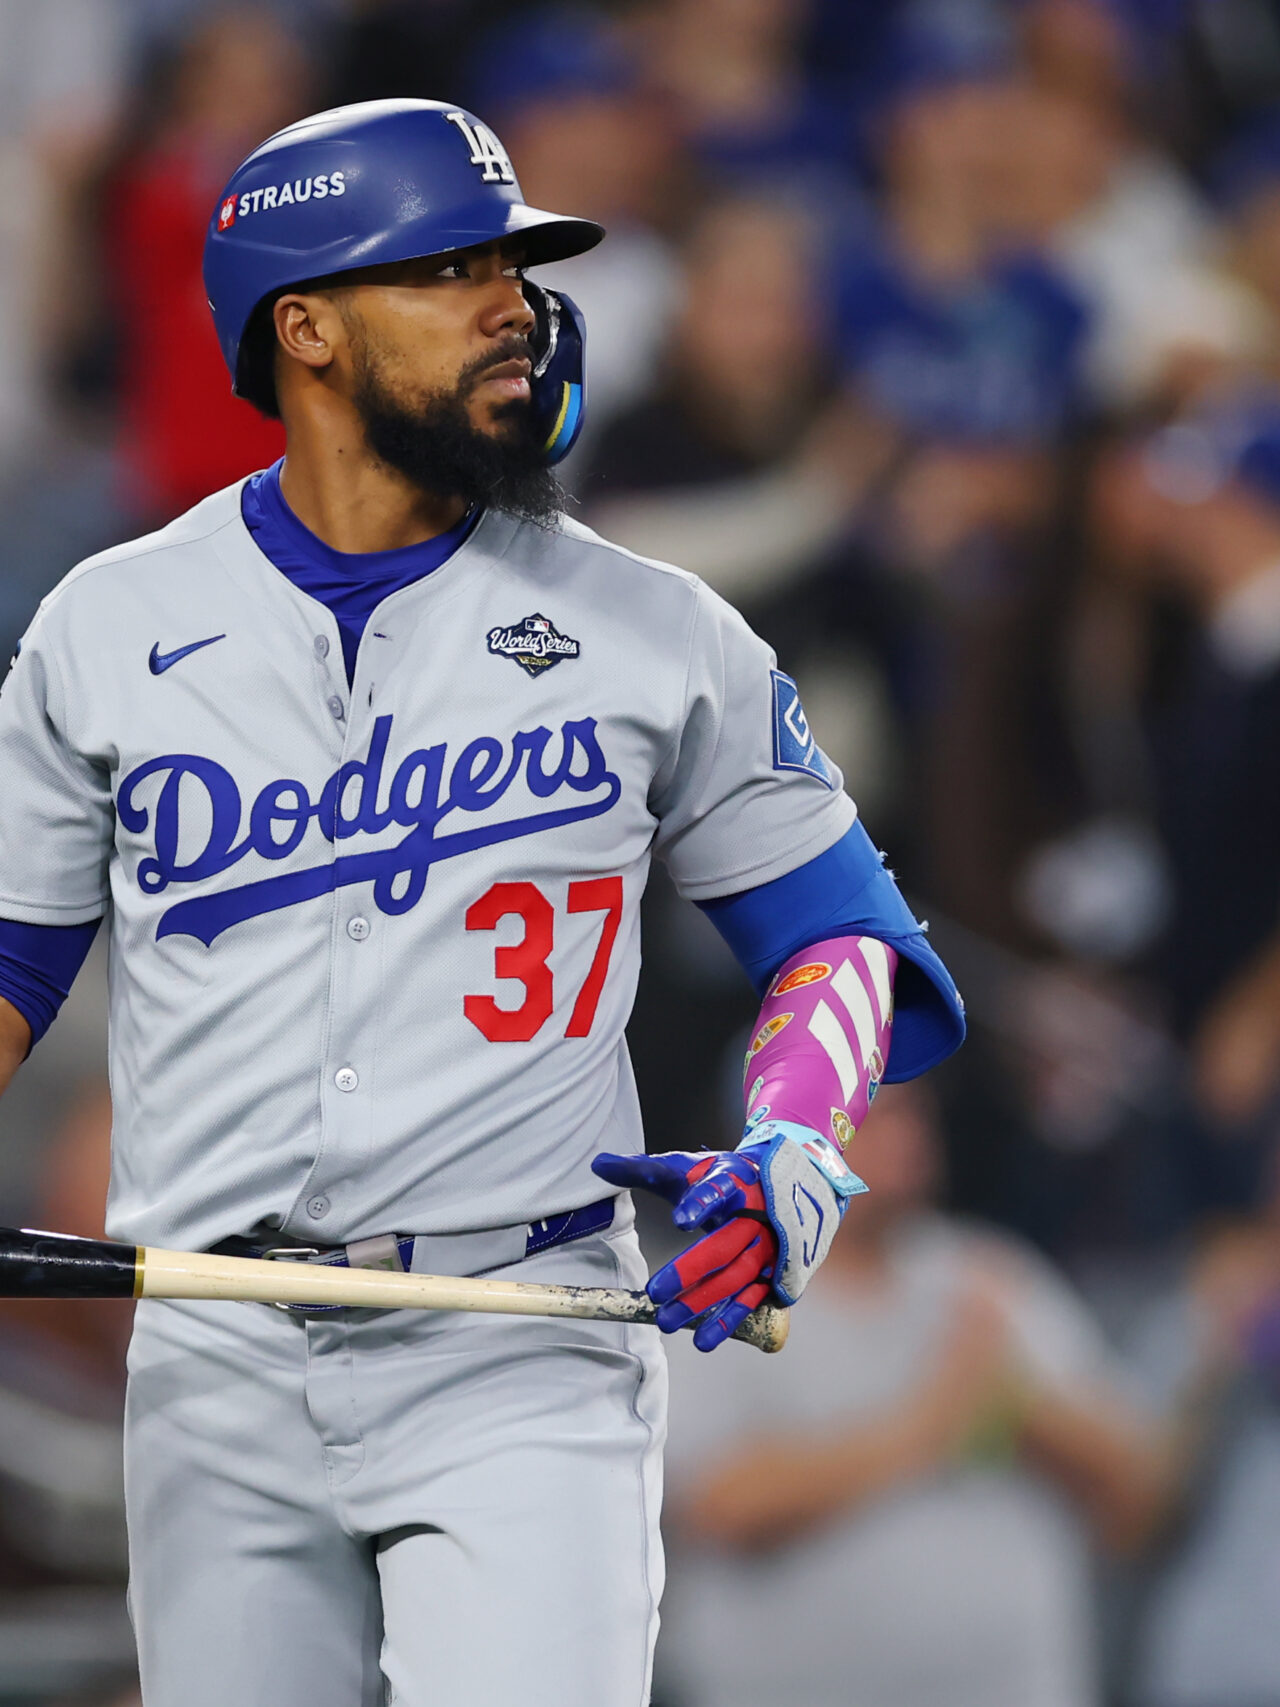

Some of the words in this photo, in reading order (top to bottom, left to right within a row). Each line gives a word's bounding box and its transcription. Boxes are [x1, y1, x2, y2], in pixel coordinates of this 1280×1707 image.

[446, 111, 515, 182] LA
[238, 171, 346, 217] STRAUSS
[490, 629, 542, 651] World
[532, 632, 578, 656] Series
[117, 714, 619, 917] Dodgers
[463, 875, 624, 1043] 37
